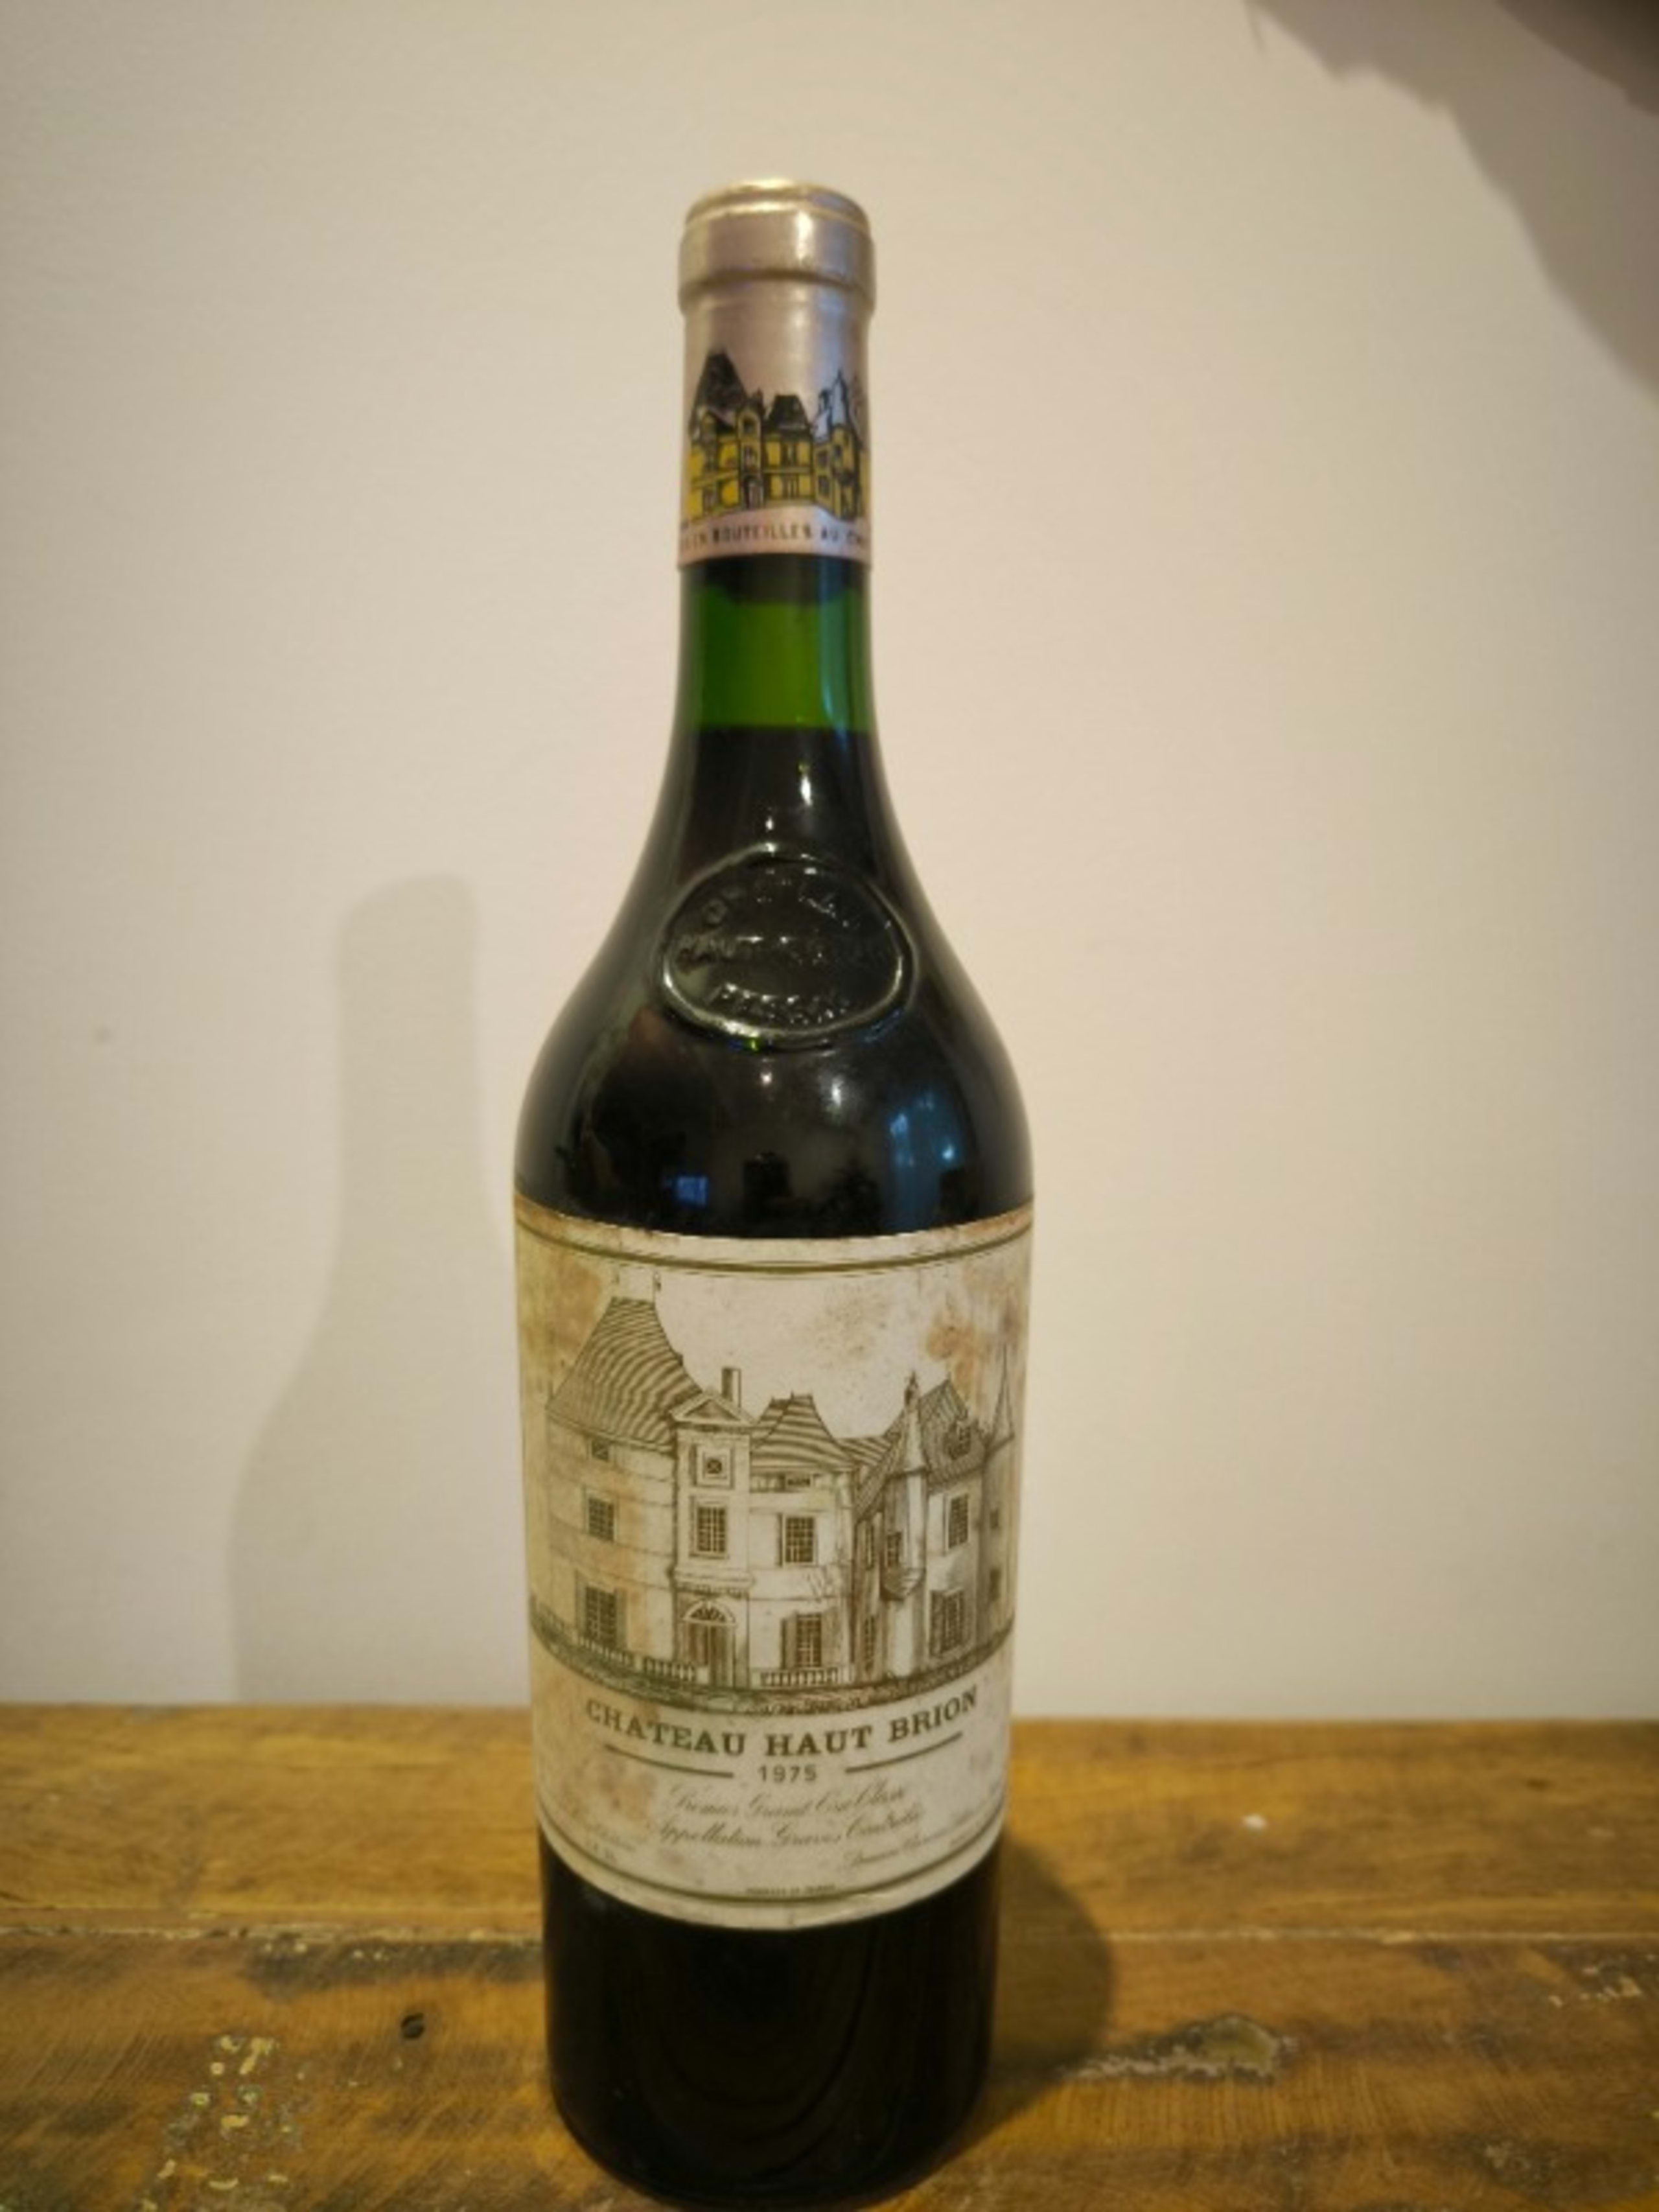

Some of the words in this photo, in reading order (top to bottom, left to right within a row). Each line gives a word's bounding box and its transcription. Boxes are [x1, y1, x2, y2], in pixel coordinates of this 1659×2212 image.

[585, 1698, 747, 1756] CHATEAU
[765, 1725, 872, 1756] HAUT
[888, 1685, 977, 1742] BRION
[758, 1765, 817, 1782] 1975
